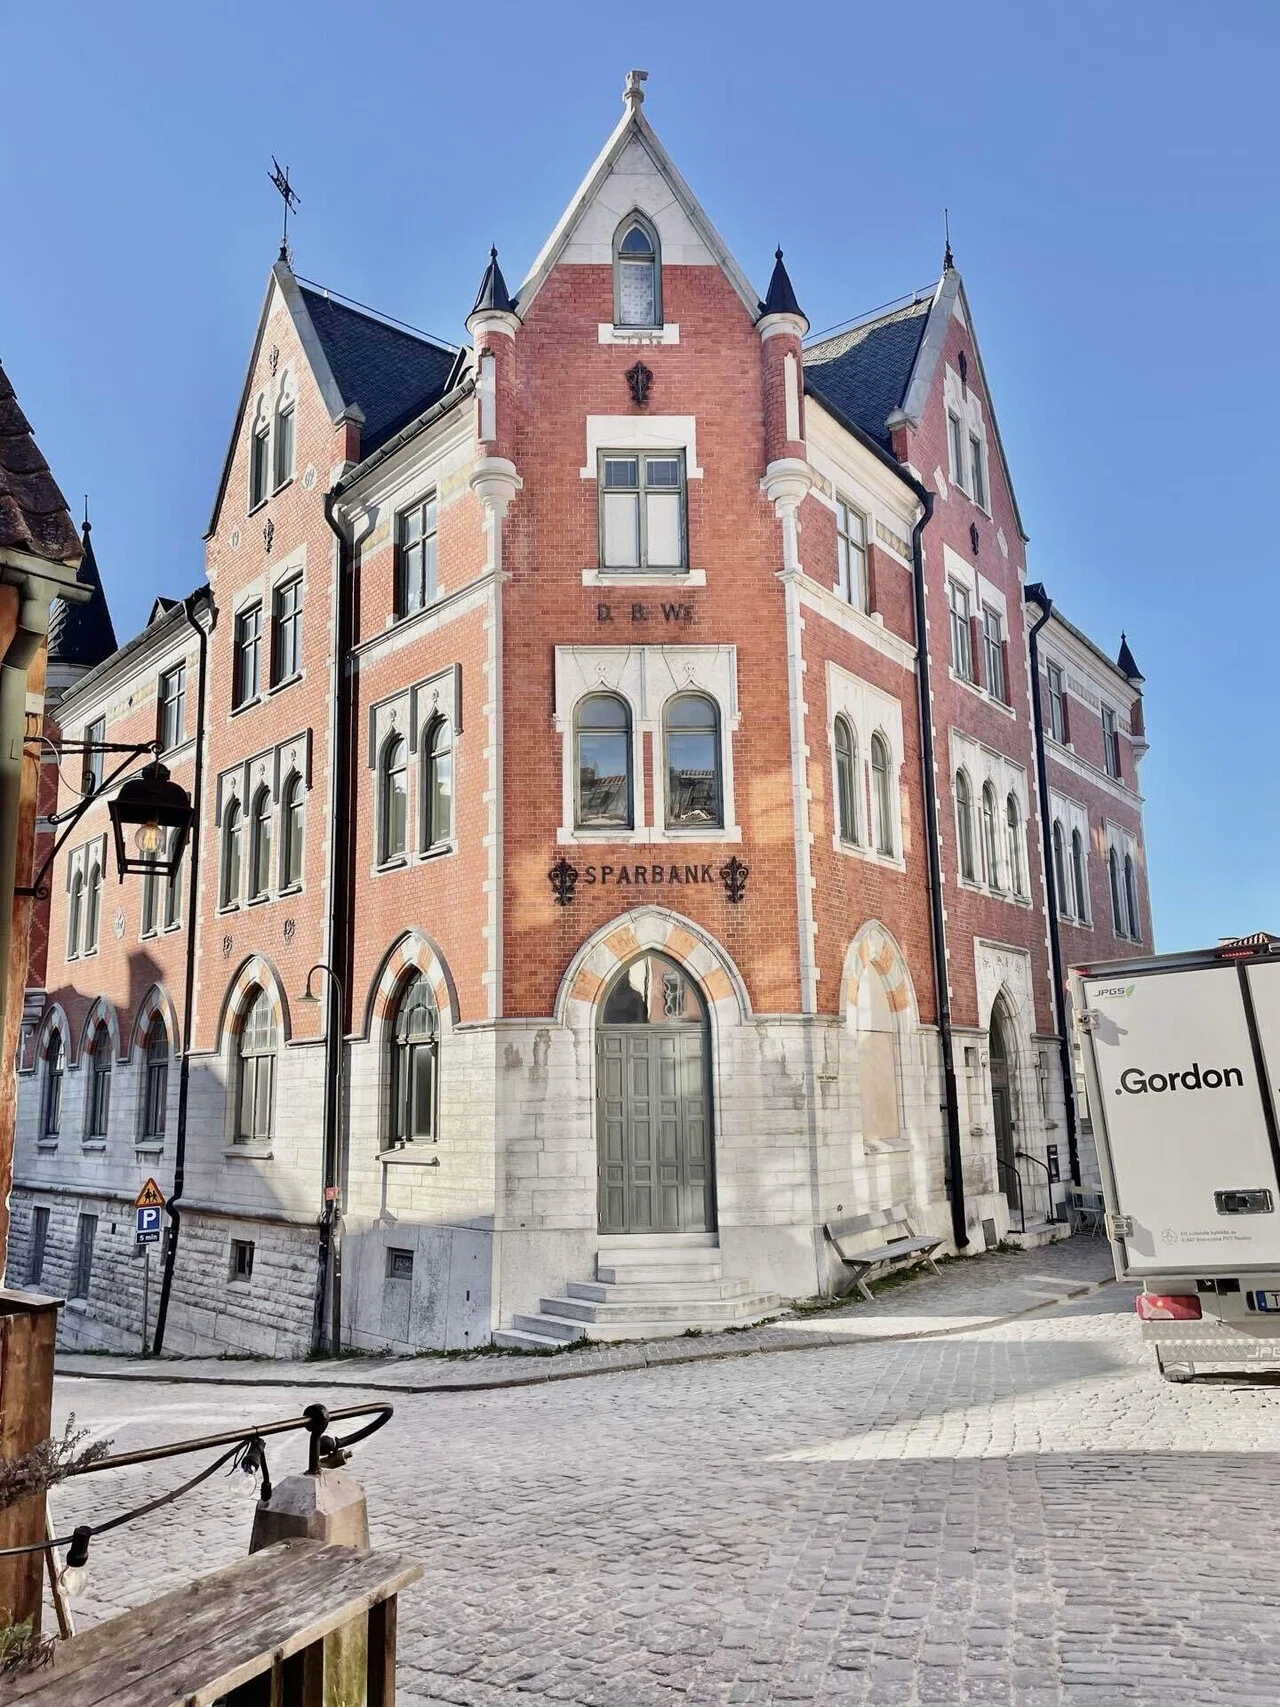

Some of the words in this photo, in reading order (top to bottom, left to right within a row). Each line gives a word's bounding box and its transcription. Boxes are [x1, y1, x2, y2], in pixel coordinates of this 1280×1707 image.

[584, 864, 715, 885] SPARBANK
[1093, 986, 1125, 997] JPGS
[143, 1209, 156, 1228] P
